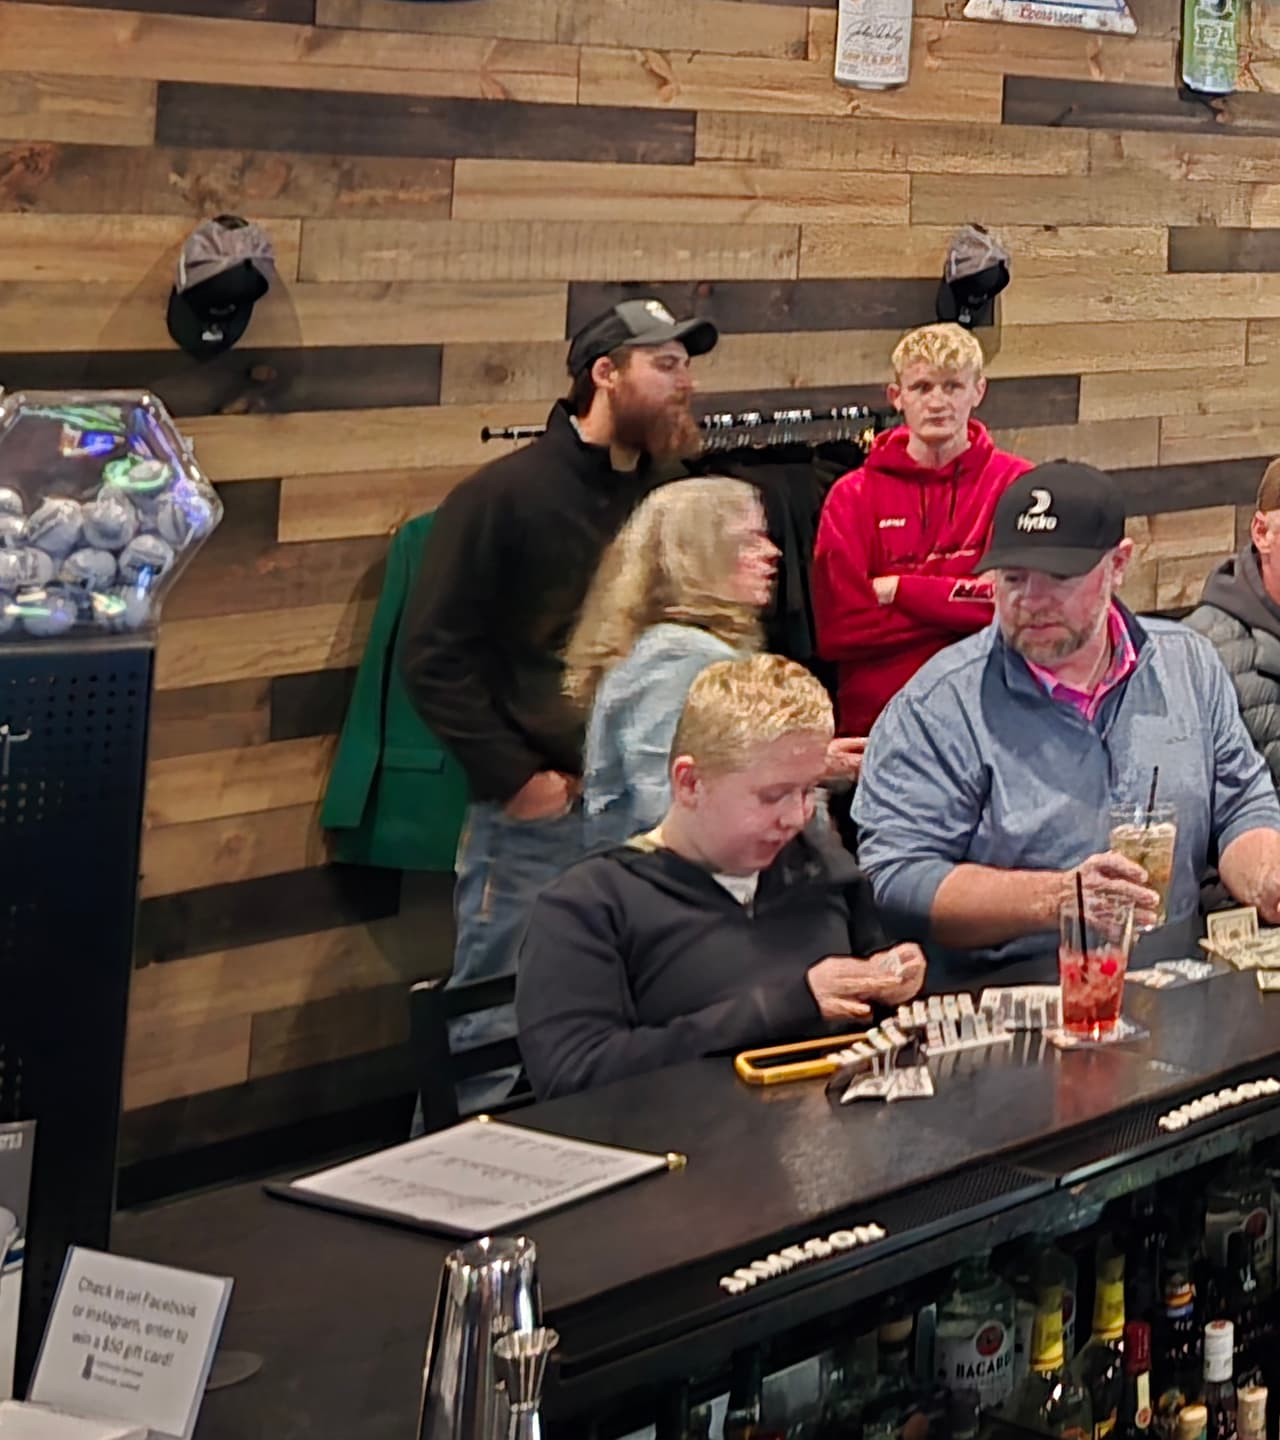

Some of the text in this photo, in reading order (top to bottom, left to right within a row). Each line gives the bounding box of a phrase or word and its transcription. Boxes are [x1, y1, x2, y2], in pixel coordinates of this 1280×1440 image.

[1017, 512, 1058, 532] Hydro
[78, 1276, 111, 1299] Check
[101, 1334, 124, 1355] $50
